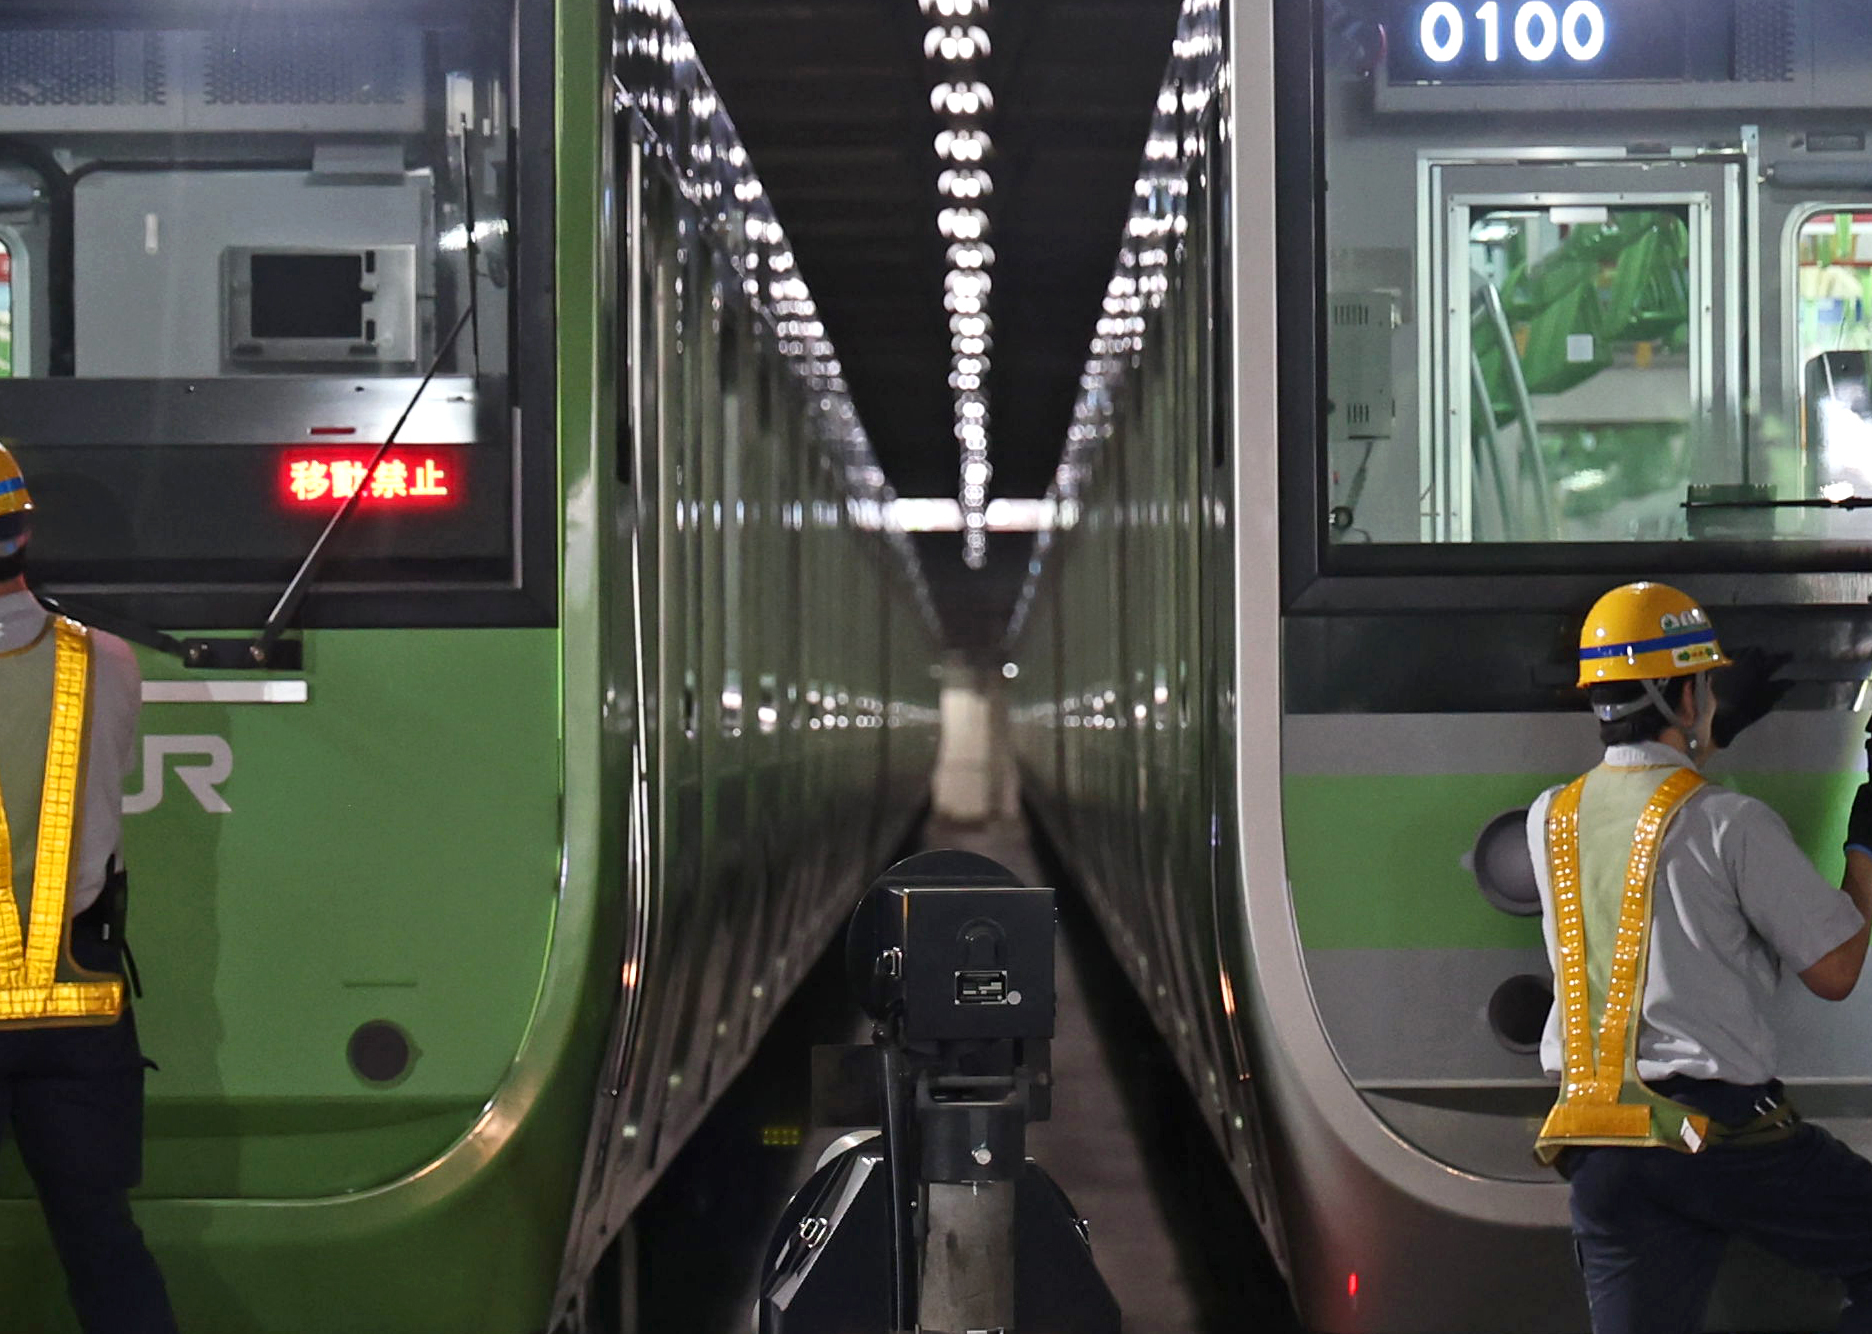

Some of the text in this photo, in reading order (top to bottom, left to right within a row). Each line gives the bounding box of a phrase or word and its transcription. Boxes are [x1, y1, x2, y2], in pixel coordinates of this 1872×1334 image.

[1420, 0, 1604, 61] 0100
[290, 459, 448, 500] 移動禁止
[122, 734, 233, 814] JR
